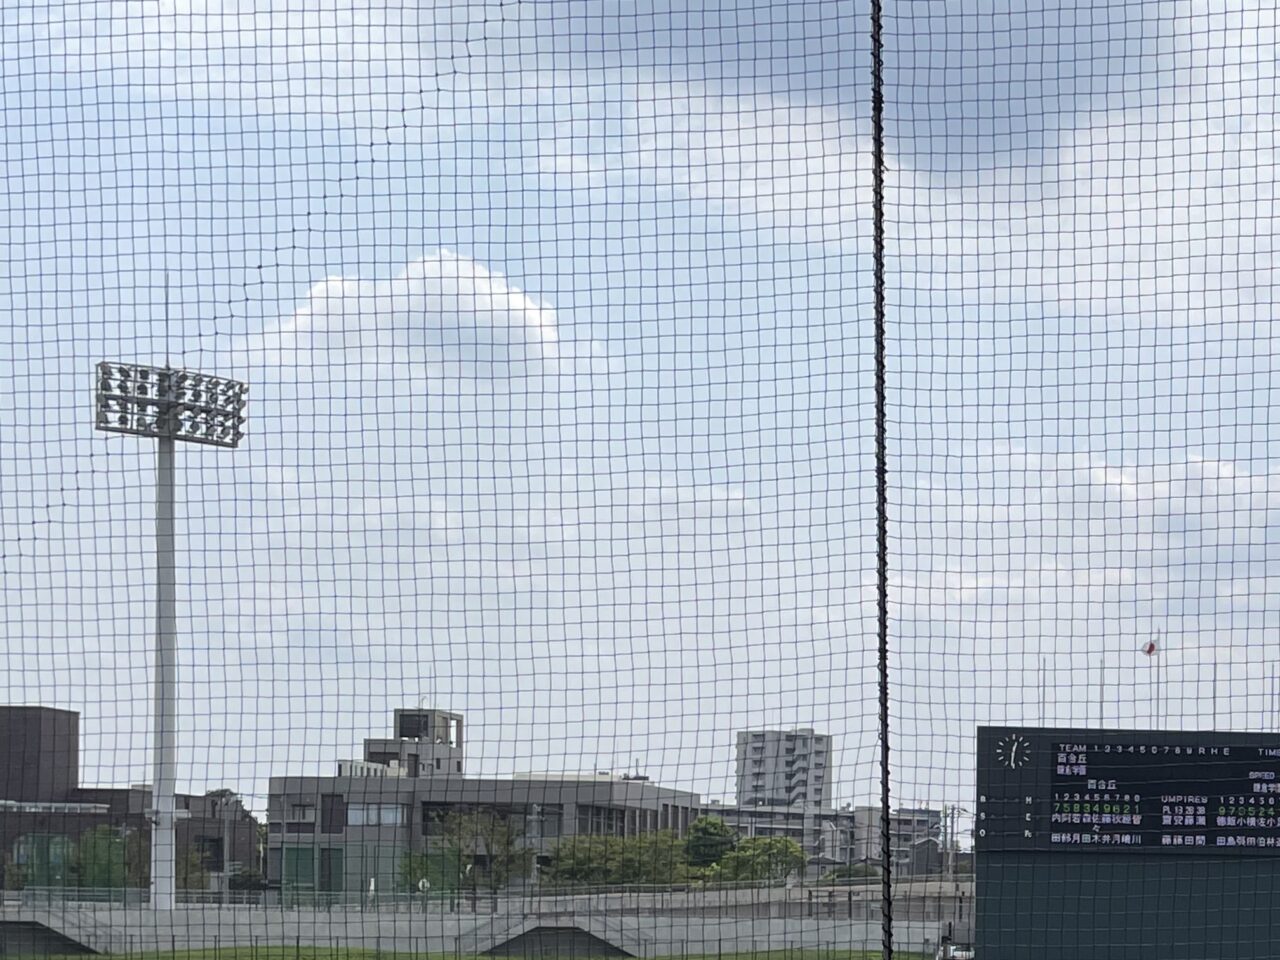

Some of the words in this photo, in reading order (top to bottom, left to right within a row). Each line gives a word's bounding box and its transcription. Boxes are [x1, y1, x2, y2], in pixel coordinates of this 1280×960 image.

[1059, 744, 1087, 752] TEAM
[1057, 753, 1087, 763] 百合丘
[1248, 771, 1275, 779] SPEED
[1087, 779, 1117, 790] 百合丘
[1161, 795, 1208, 804] UMPIRES
[1162, 806, 1172, 814] PL
